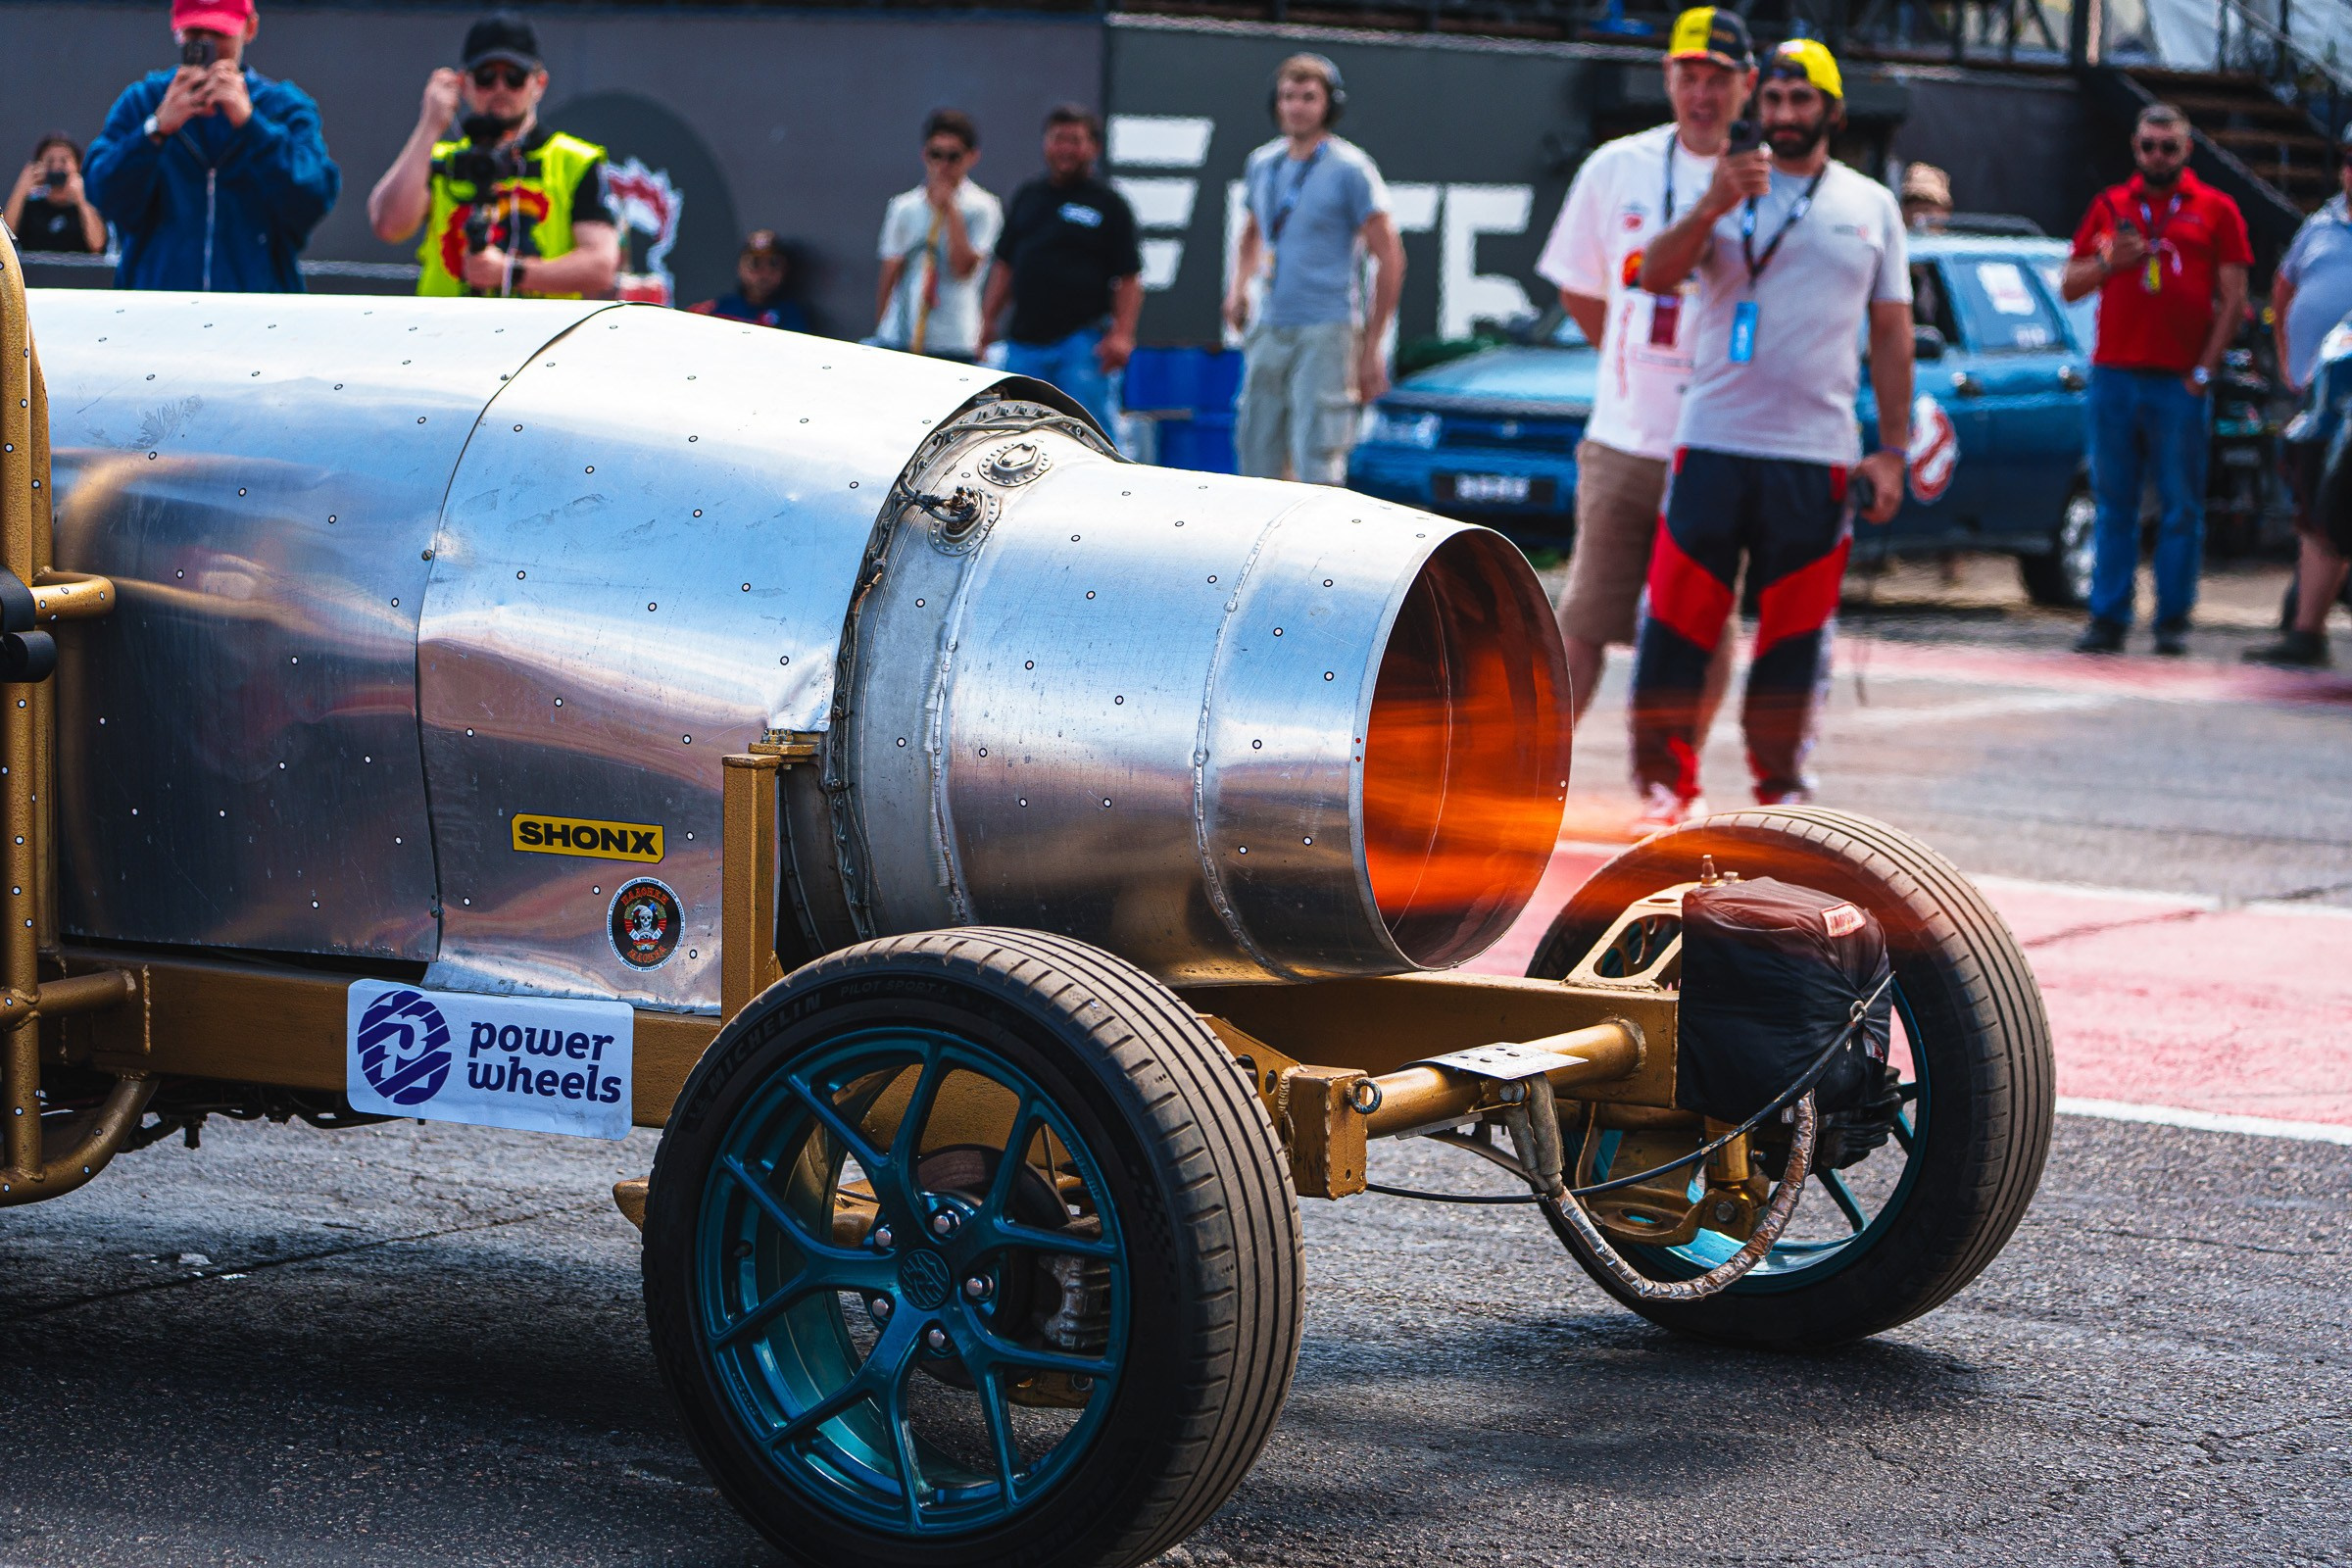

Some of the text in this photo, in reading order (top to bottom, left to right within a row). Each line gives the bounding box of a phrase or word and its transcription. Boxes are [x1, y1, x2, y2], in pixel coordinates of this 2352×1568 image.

[518, 820, 659, 857] SHONX
[840, 980, 881, 998] PILOT
[886, 979, 937, 995] SPORT
[468, 1021, 614, 1061] power
[708, 993, 822, 1095] MICHELIN
[466, 1056, 622, 1103] wheels
